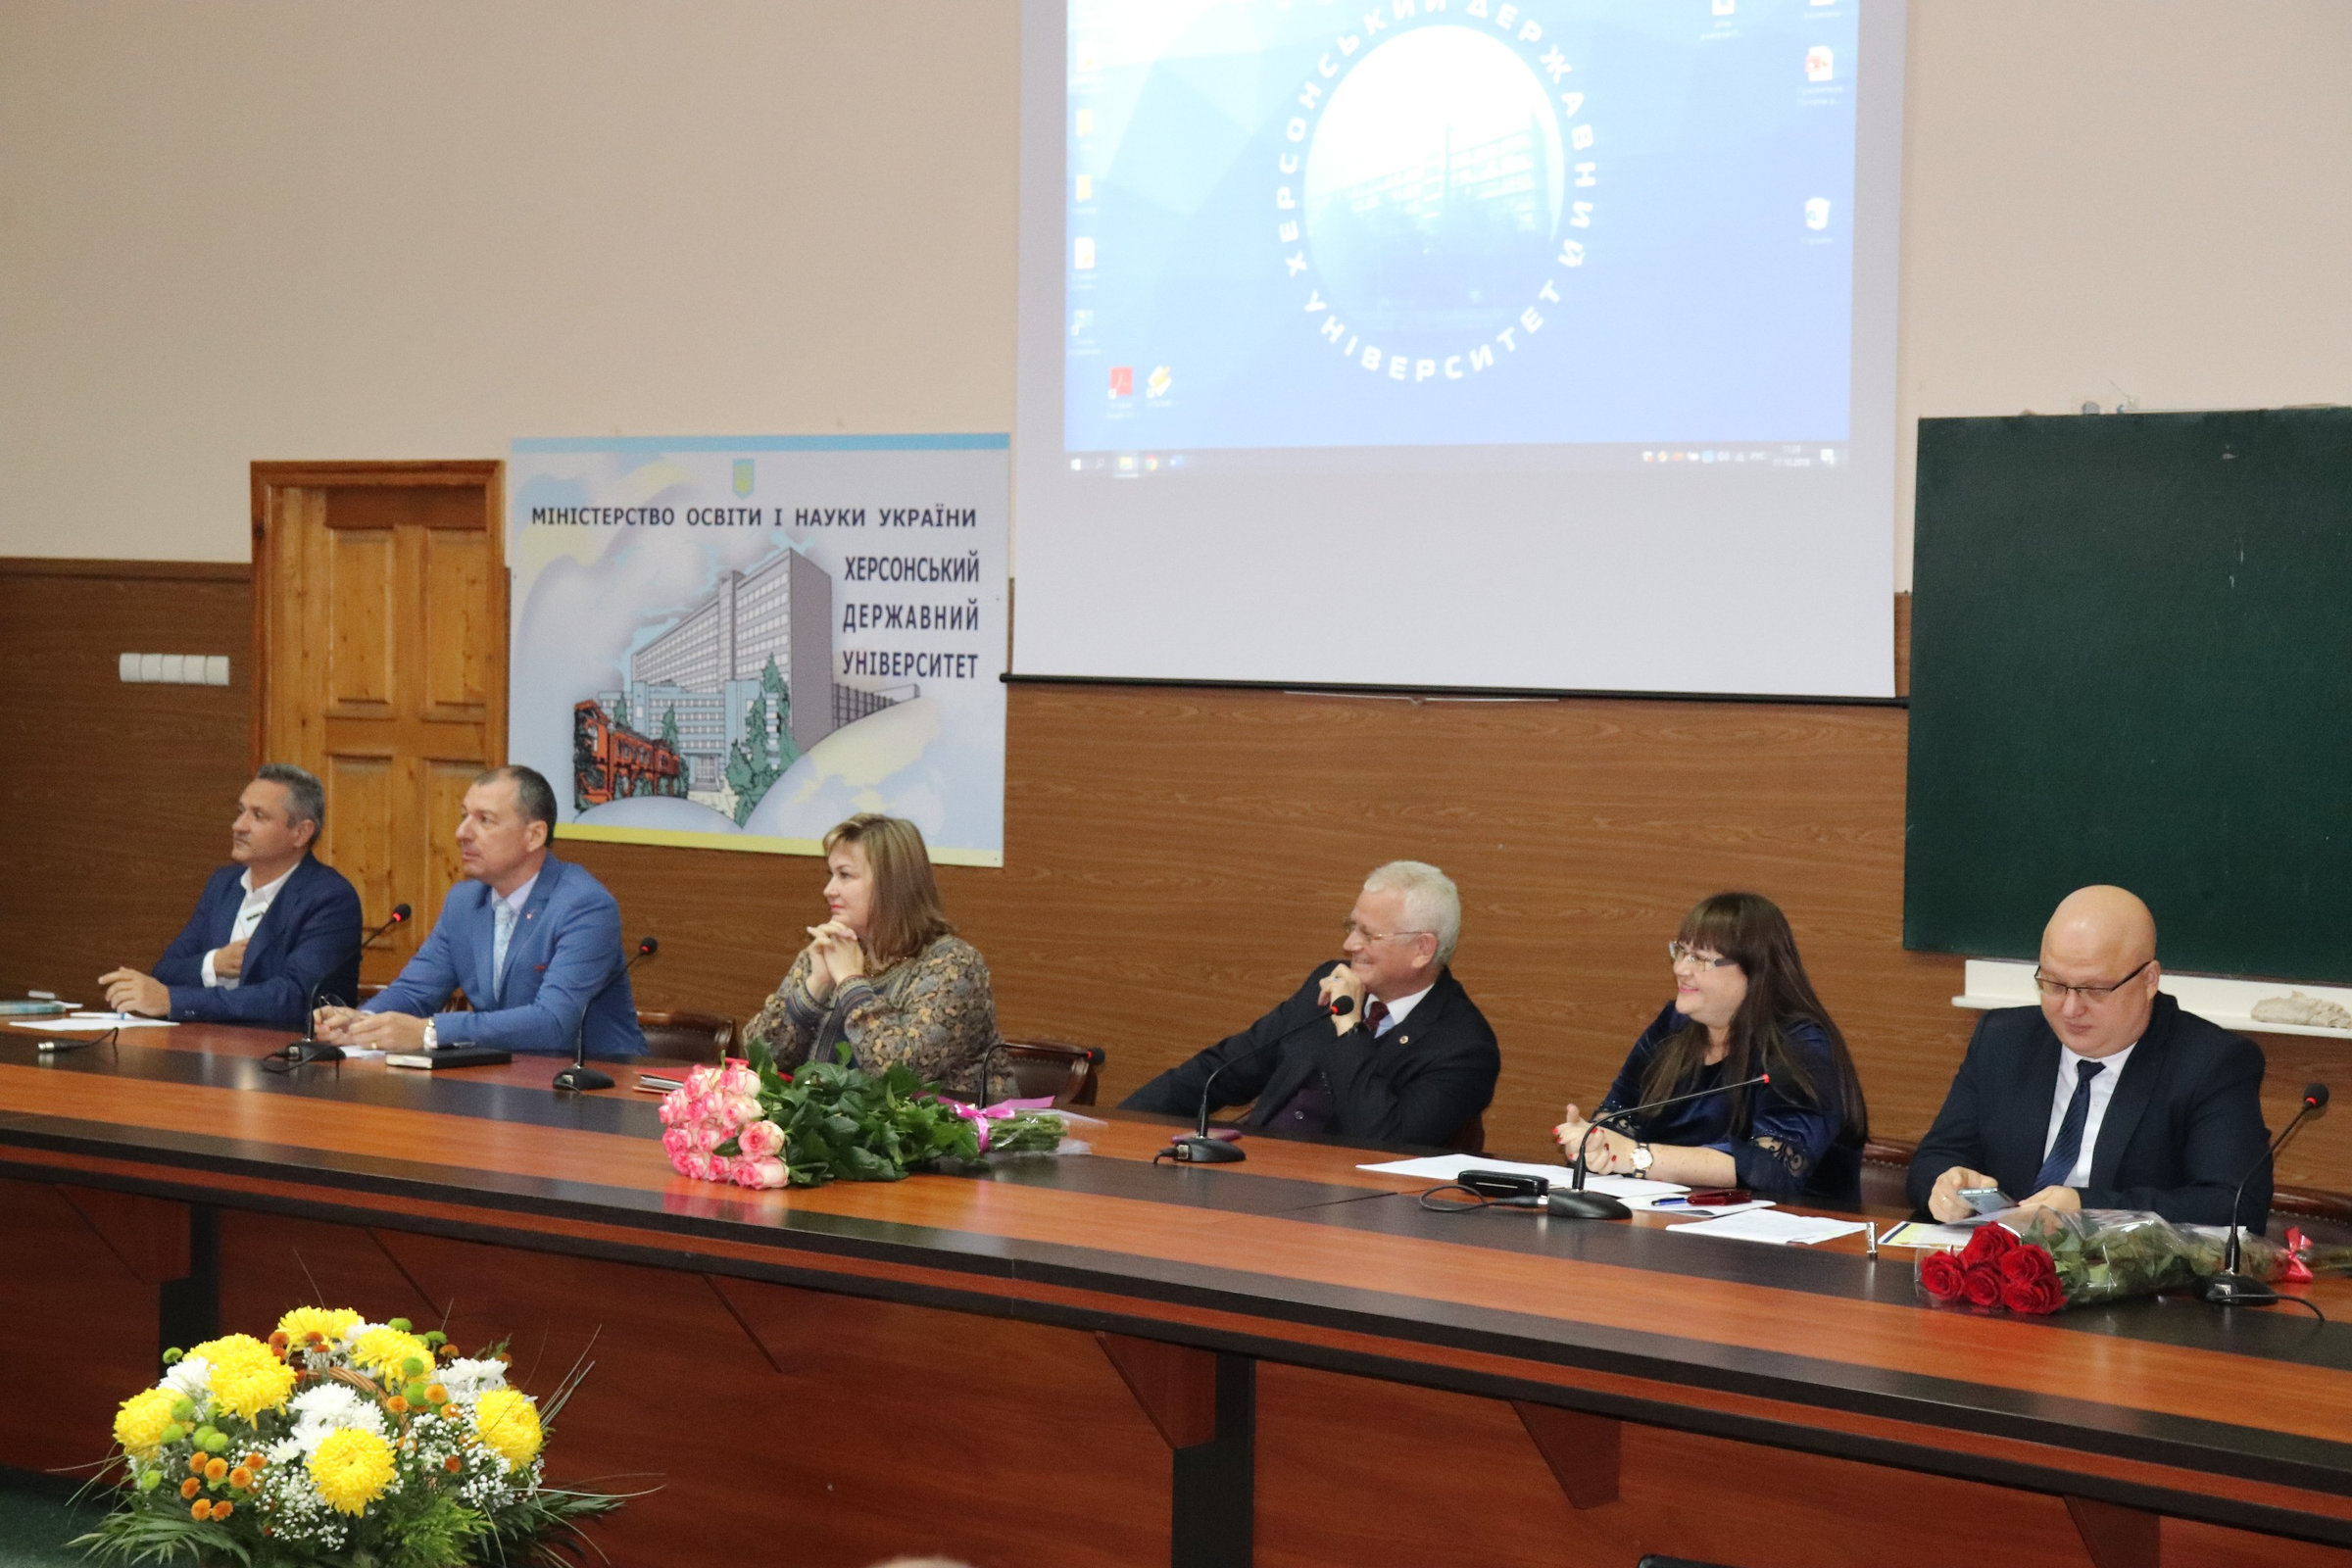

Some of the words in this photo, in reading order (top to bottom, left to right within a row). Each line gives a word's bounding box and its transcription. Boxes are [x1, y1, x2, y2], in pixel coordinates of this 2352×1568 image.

[1466, 0, 1596, 268] ДЕРЖАВНИЙ
[1304, 279, 1561, 382] УНІВЕРСИТЕТ
[532, 507, 675, 526] МІНІСТЕРСТВО
[686, 508, 761, 526] ОСВІТИ
[774, 508, 783, 526] І
[795, 508, 865, 526] НАУКИ
[879, 504, 976, 527] УКРАЇНИ
[845, 551, 979, 582] ХЕРСОНСЬКИЙ
[843, 599, 979, 632] ДЕРЖАВНИЙ
[843, 651, 978, 678] УНІВЕРСИТЕТ
